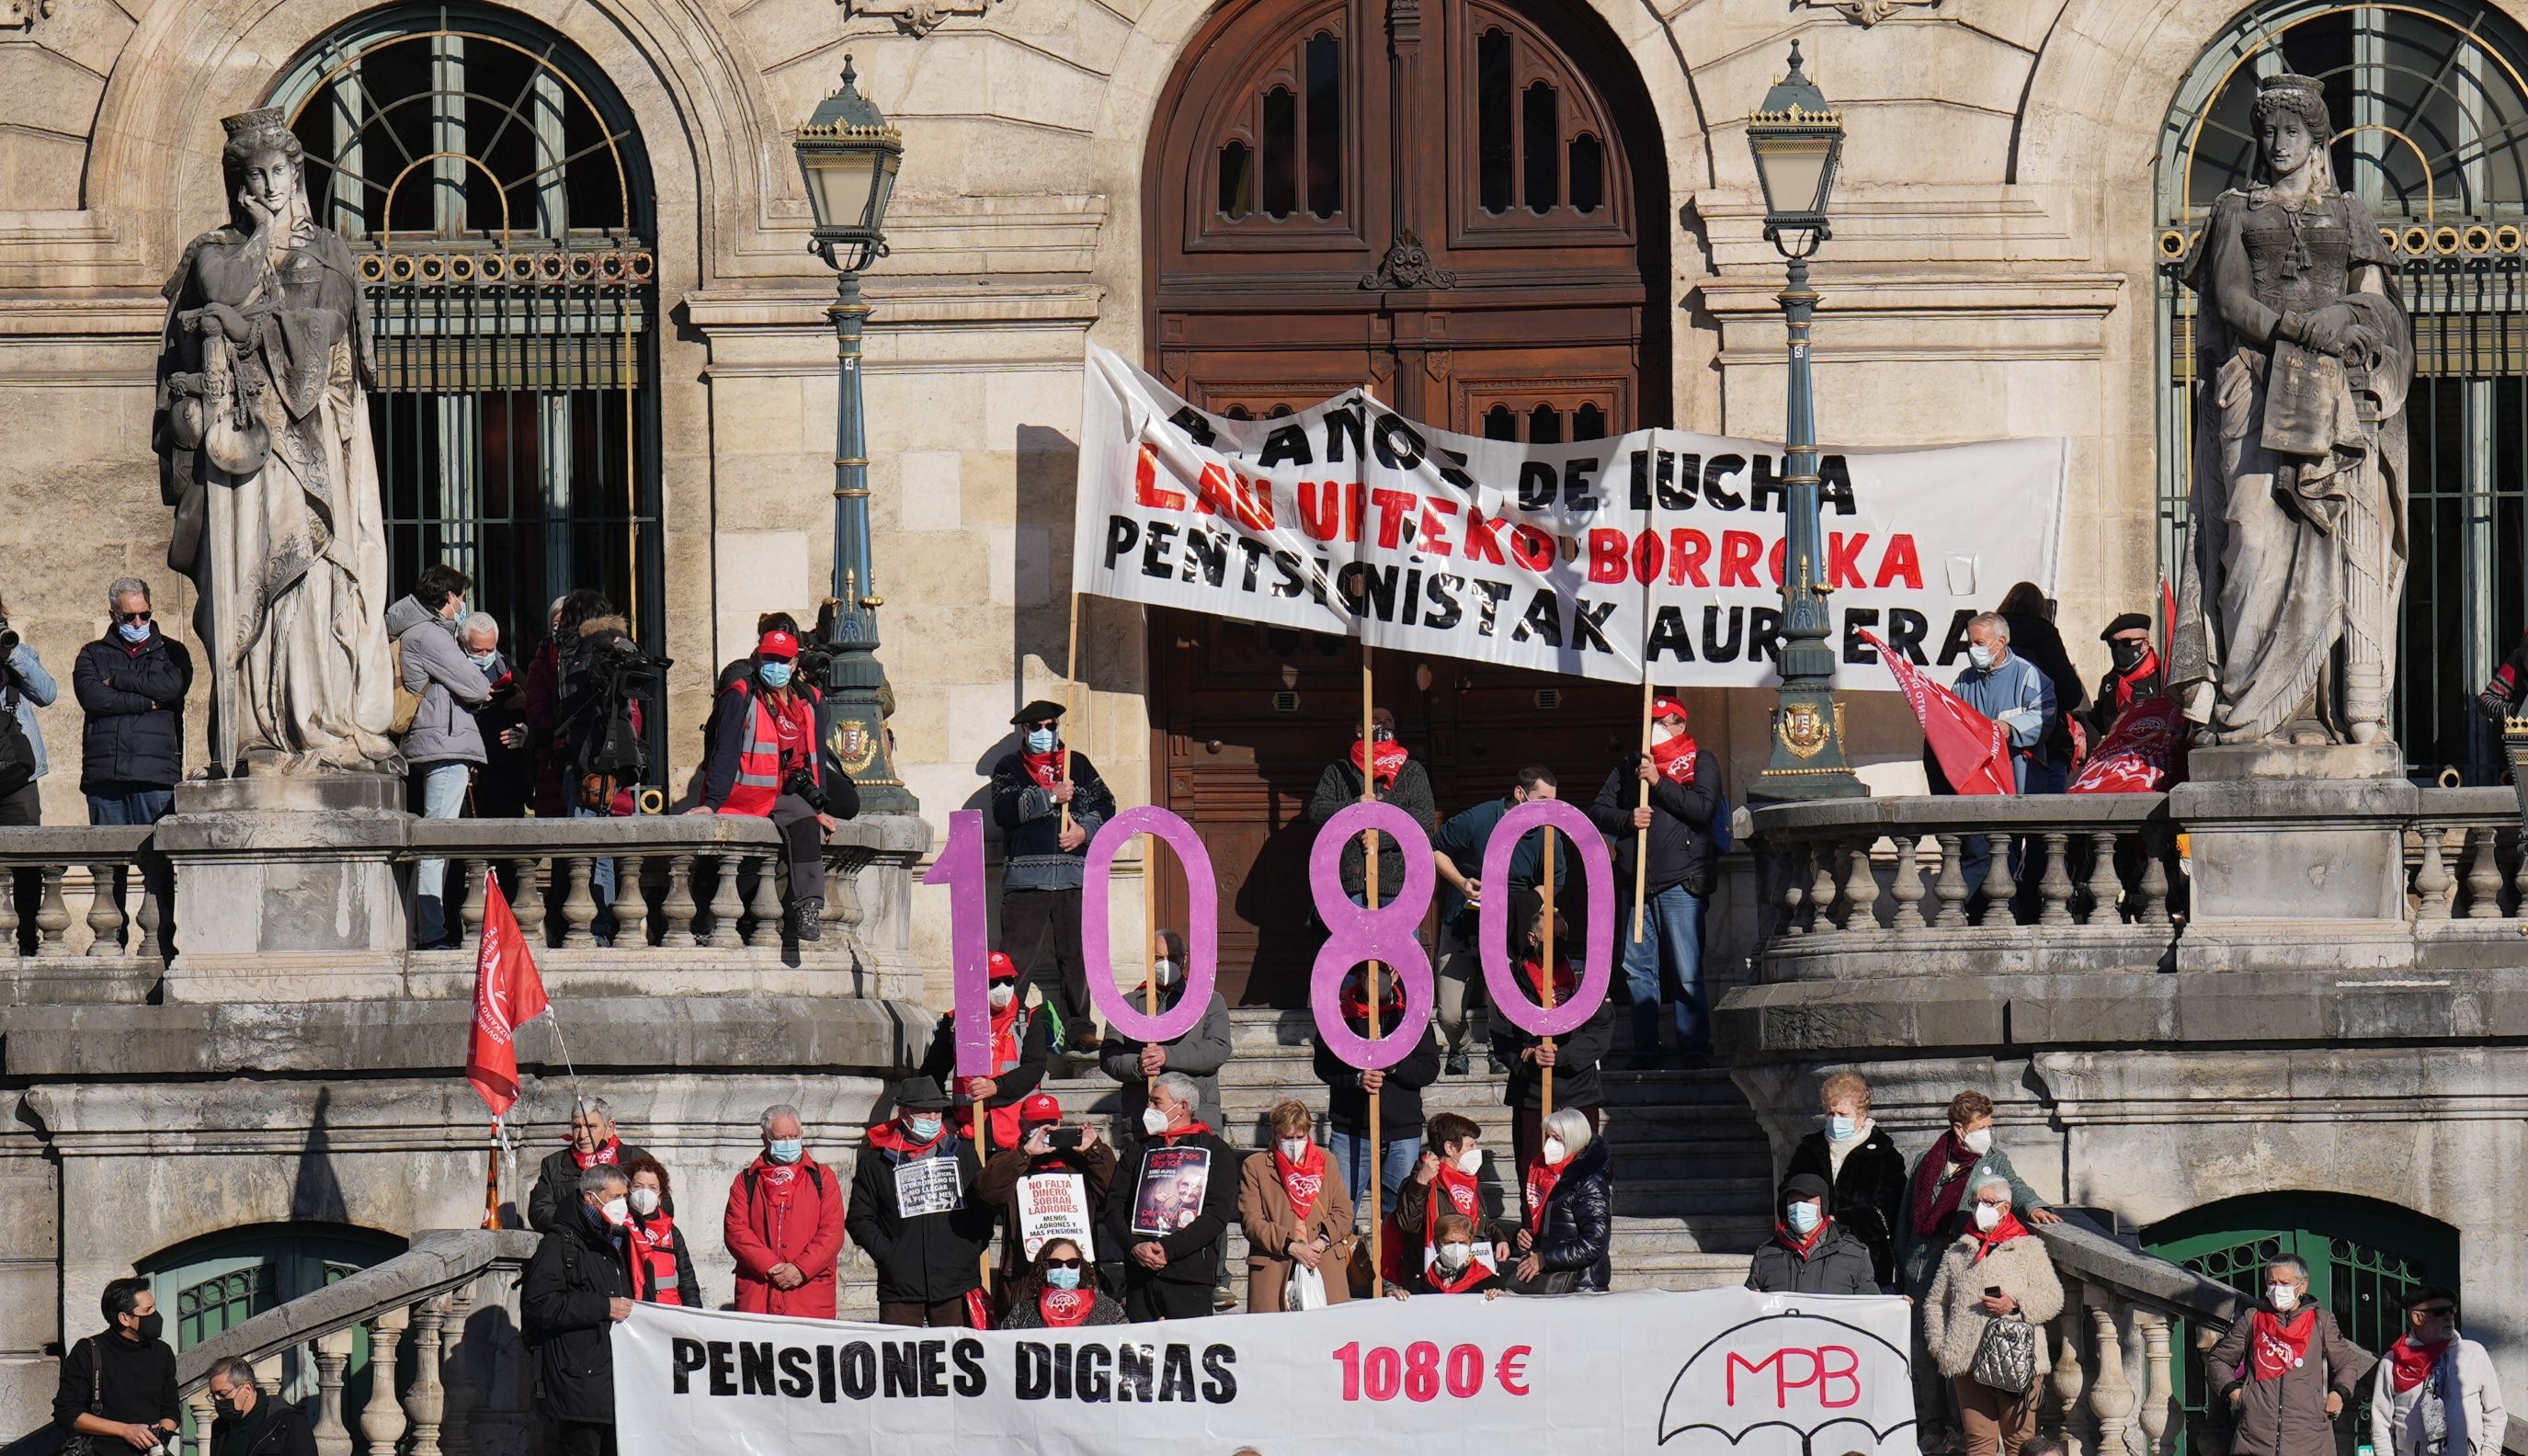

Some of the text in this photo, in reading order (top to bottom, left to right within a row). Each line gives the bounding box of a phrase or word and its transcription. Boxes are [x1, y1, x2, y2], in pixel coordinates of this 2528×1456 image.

[1796, 347, 1802, 357] 5
[847, 359, 852, 368] 4
[1518, 457, 1599, 512] DE
[1630, 449, 1857, 516] LUCHA
[1646, 605, 1978, 667] AURERA
[1029, 1180, 1072, 1190] NO FALTA
[1032, 1196, 1072, 1206] SOBRAN
[1028, 1205, 1078, 1215] LADRONES
[1035, 1222, 1071, 1230] LADRONES
[671, 1337, 1532, 1405] PENSIONES DIGNAS 1080 €
[1726, 1346, 1861, 1409] MPB
